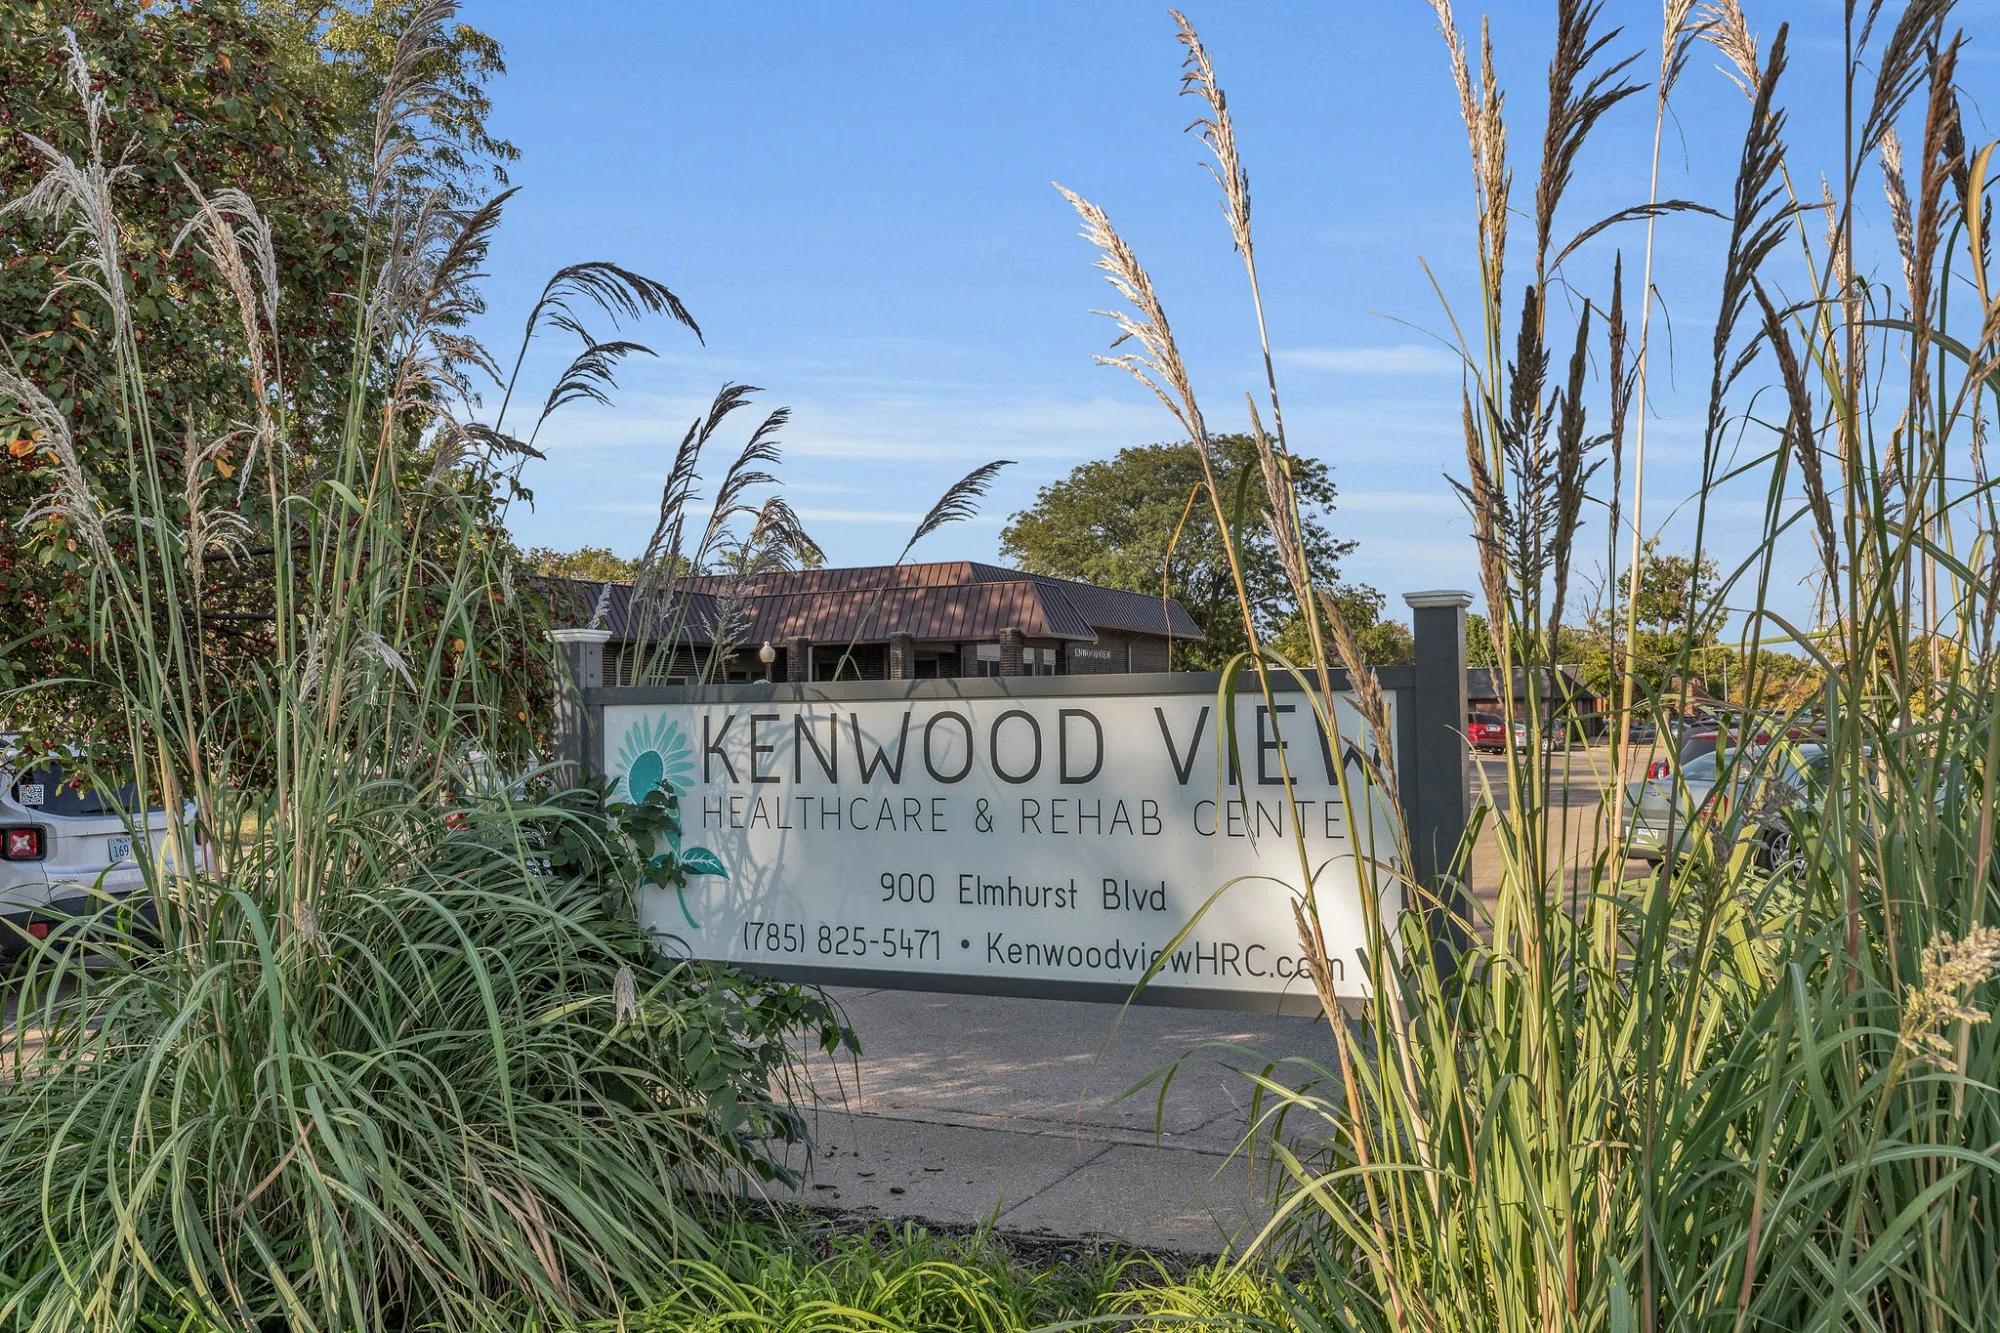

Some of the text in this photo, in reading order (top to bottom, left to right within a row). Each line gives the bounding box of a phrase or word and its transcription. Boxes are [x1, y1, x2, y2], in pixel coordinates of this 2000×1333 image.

[703, 709, 1104, 785] KENWOOD
[703, 796, 947, 832] HEALTHCARE
[975, 797, 994, 833] &
[1021, 798, 1163, 836] REHAB
[880, 872, 1167, 912] 900 Elmhurst Blvd
[743, 922, 805, 953] (785)
[818, 926, 941, 961] 825-5471
